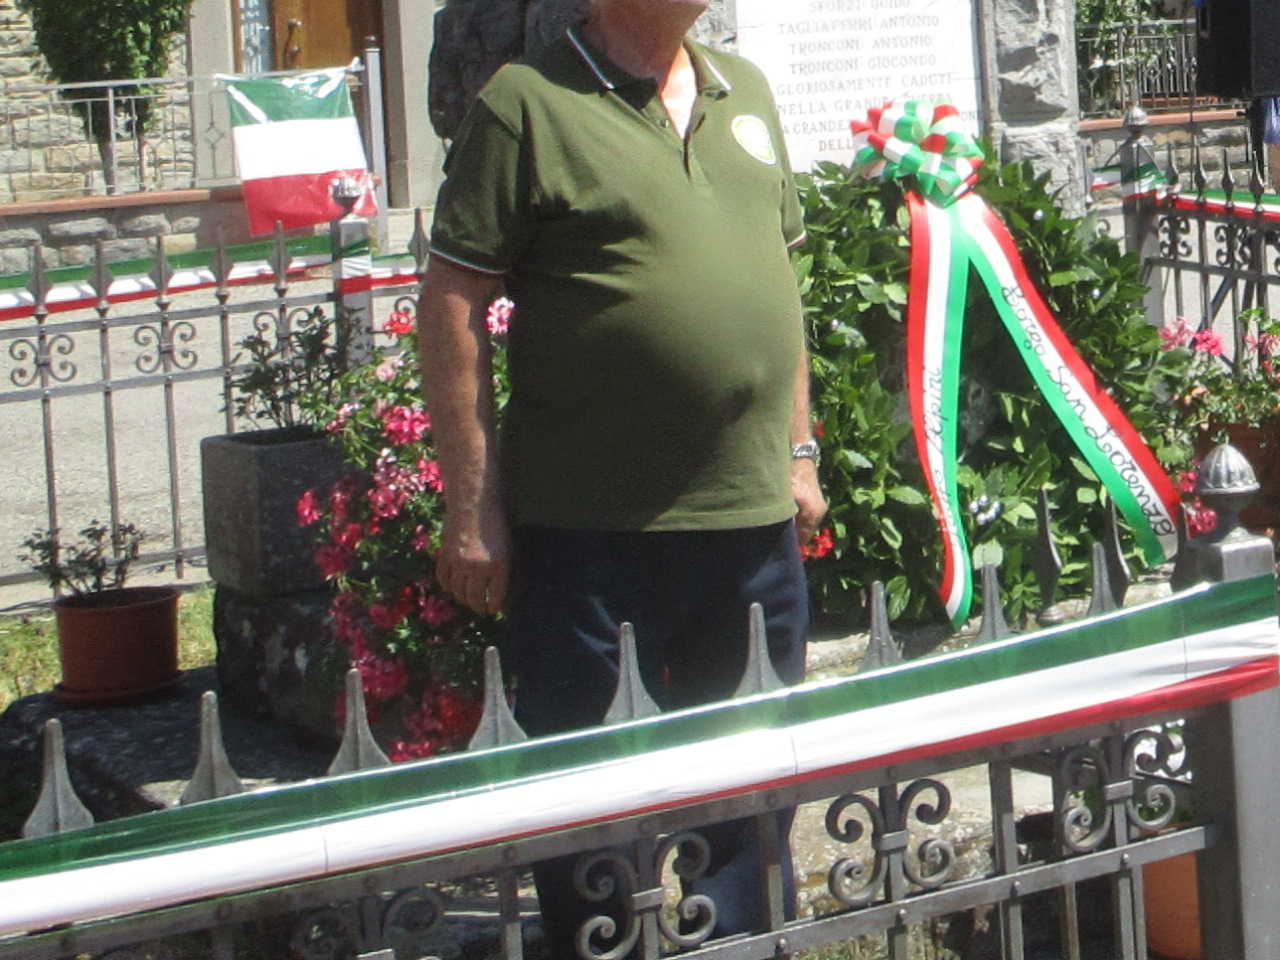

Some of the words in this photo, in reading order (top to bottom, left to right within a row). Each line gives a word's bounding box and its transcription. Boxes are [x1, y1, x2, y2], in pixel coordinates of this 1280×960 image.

[777, 16, 873, 34] TAGLIAFERRI
[880, 14, 940, 29] ANTONIO
[788, 39, 861, 55] TRONCONI
[872, 33, 932, 49] ANTONIO
[788, 56, 860, 74] TRONCONI
[868, 53, 936, 70] GIOCONDO
[776, 76, 891, 96] GLORIOSAMENTE
[901, 72, 952, 88] CADUTI
[776, 98, 827, 116] NELLA
[1001, 284, 1046, 356] Borgo
[1047, 365, 1087, 423] San
[1085, 424, 1176, 537] Lorenzo
